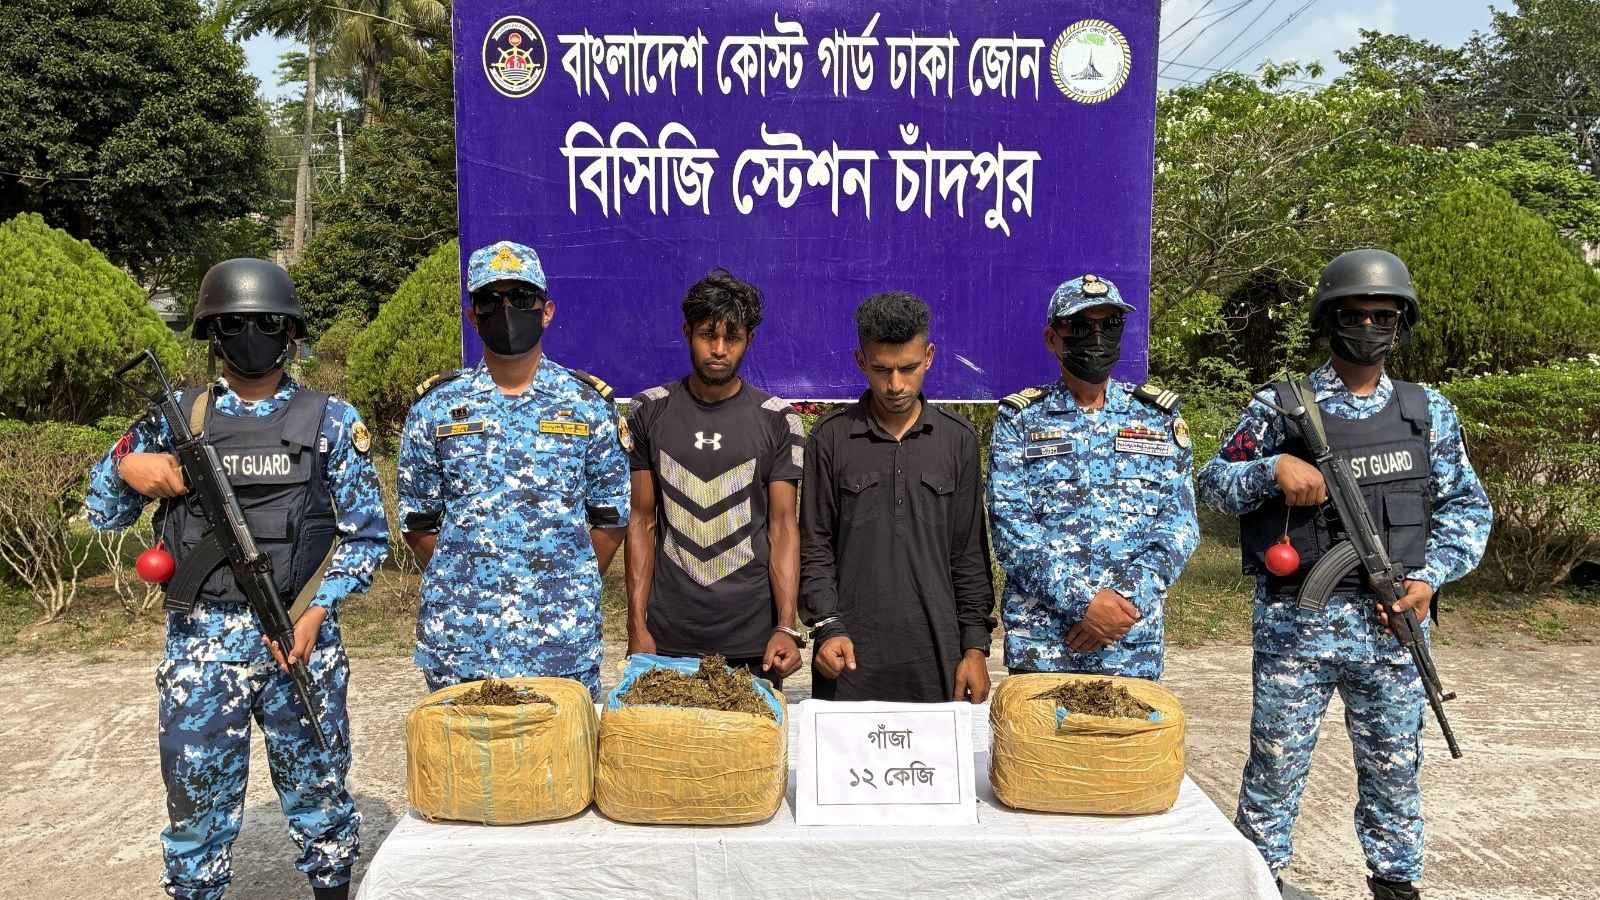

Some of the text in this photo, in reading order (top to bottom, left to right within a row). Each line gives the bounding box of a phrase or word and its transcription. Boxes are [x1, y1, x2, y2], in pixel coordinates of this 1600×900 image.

[558, 27, 708, 100] বাংলাদেশ
[717, 13, 808, 96] কোস্ট
[818, 12, 880, 97] গার্ড
[886, 31, 960, 98] ঢাকা
[969, 32, 1045, 101] জোন
[560, 122, 1041, 236] বিসিজি স্টেশন চাঁদপুর
[242, 454, 291, 476] GUARD
[1370, 450, 1413, 476] GUARD
[868, 724, 912, 750] গাঁজা
[849, 761, 936, 789] ১২ কেজি
